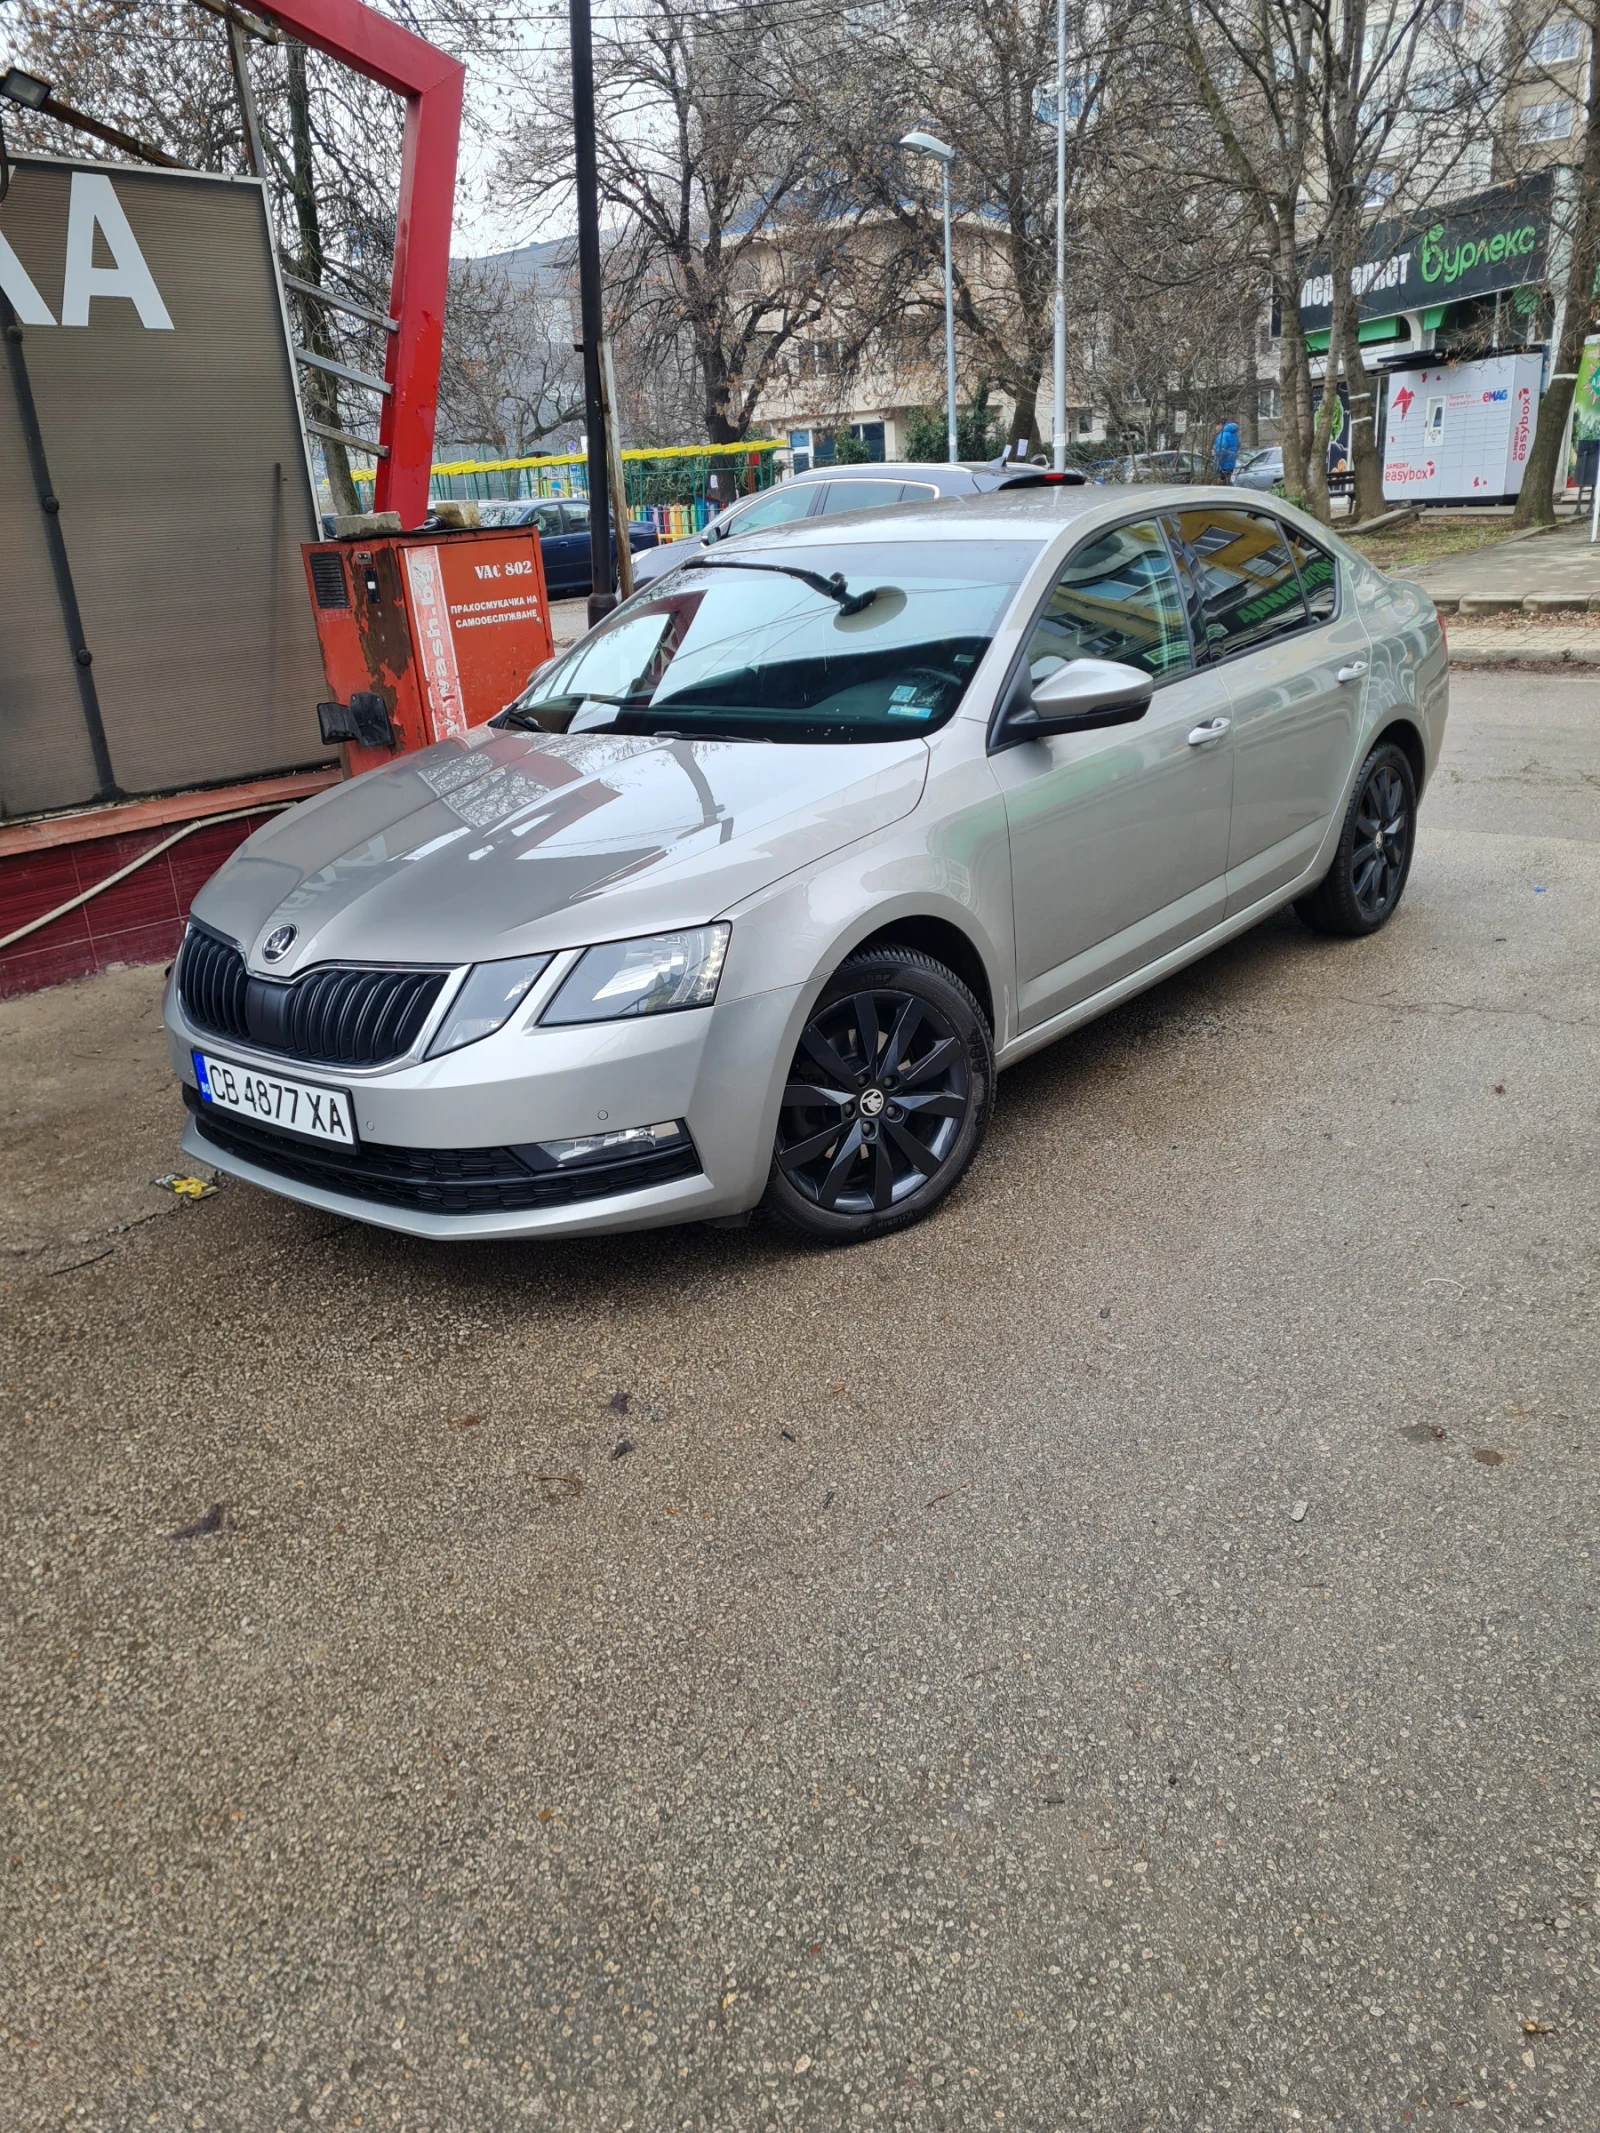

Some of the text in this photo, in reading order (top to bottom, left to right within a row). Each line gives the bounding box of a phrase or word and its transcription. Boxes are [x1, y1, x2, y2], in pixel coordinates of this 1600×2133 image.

[1482, 389, 1508, 403] eMAG
[1518, 397, 1531, 461] easybox
[1386, 461, 1409, 469] SAMEDAY
[1385, 467, 1429, 484] easybox
[474, 560, 532, 579] VAC 802
[450, 595, 538, 615] ПРАХОСМУКАЧКА НА
[455, 609, 537, 628] САМООБСЛУЖВАНЕ
[201, 1081, 211, 1094] BG
[209, 1064, 347, 1137] CB 4877 XA
